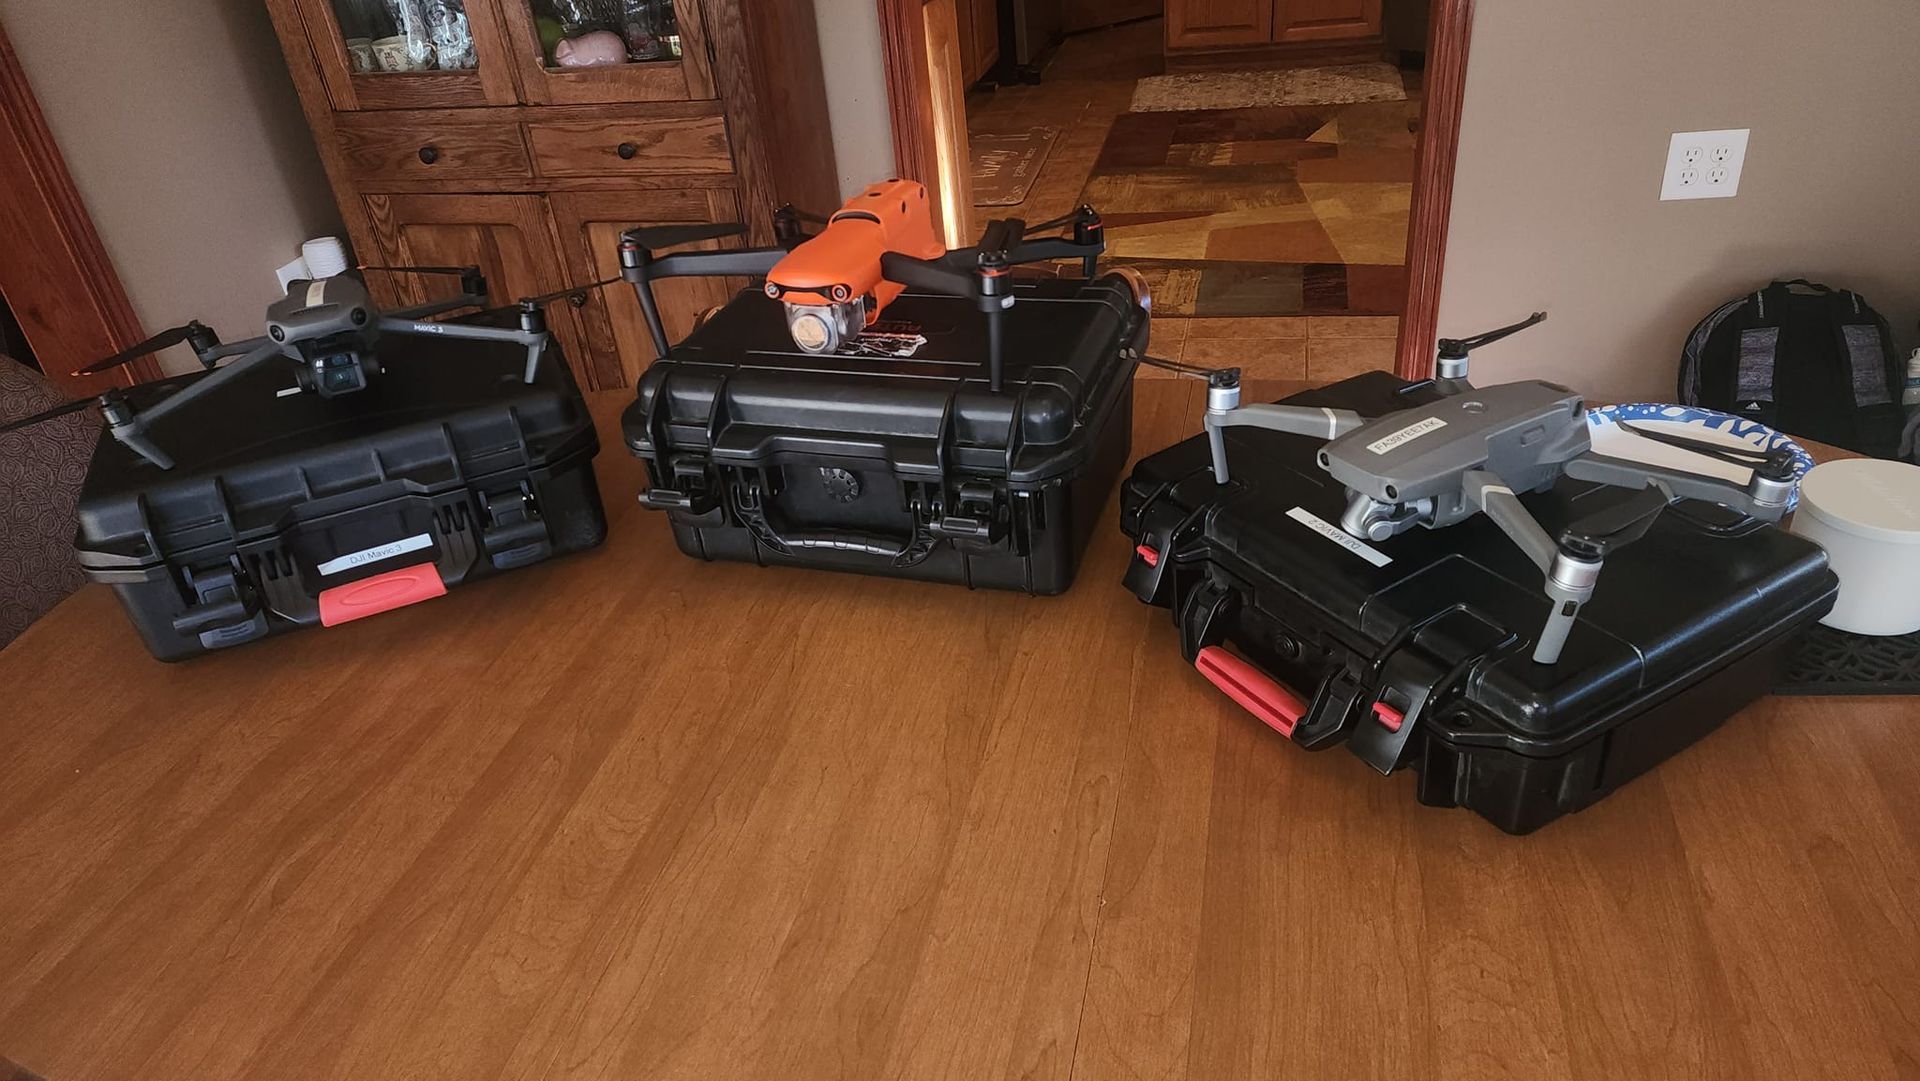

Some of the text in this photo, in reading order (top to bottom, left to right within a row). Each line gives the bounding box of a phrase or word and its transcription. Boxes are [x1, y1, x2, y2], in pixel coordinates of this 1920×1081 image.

[413, 324, 444, 334] MAVIC 3
[1314, 522, 1345, 541] MAVIC
[1343, 538, 1361, 550] DJI
[349, 544, 403, 564] DJI Mavic 3
